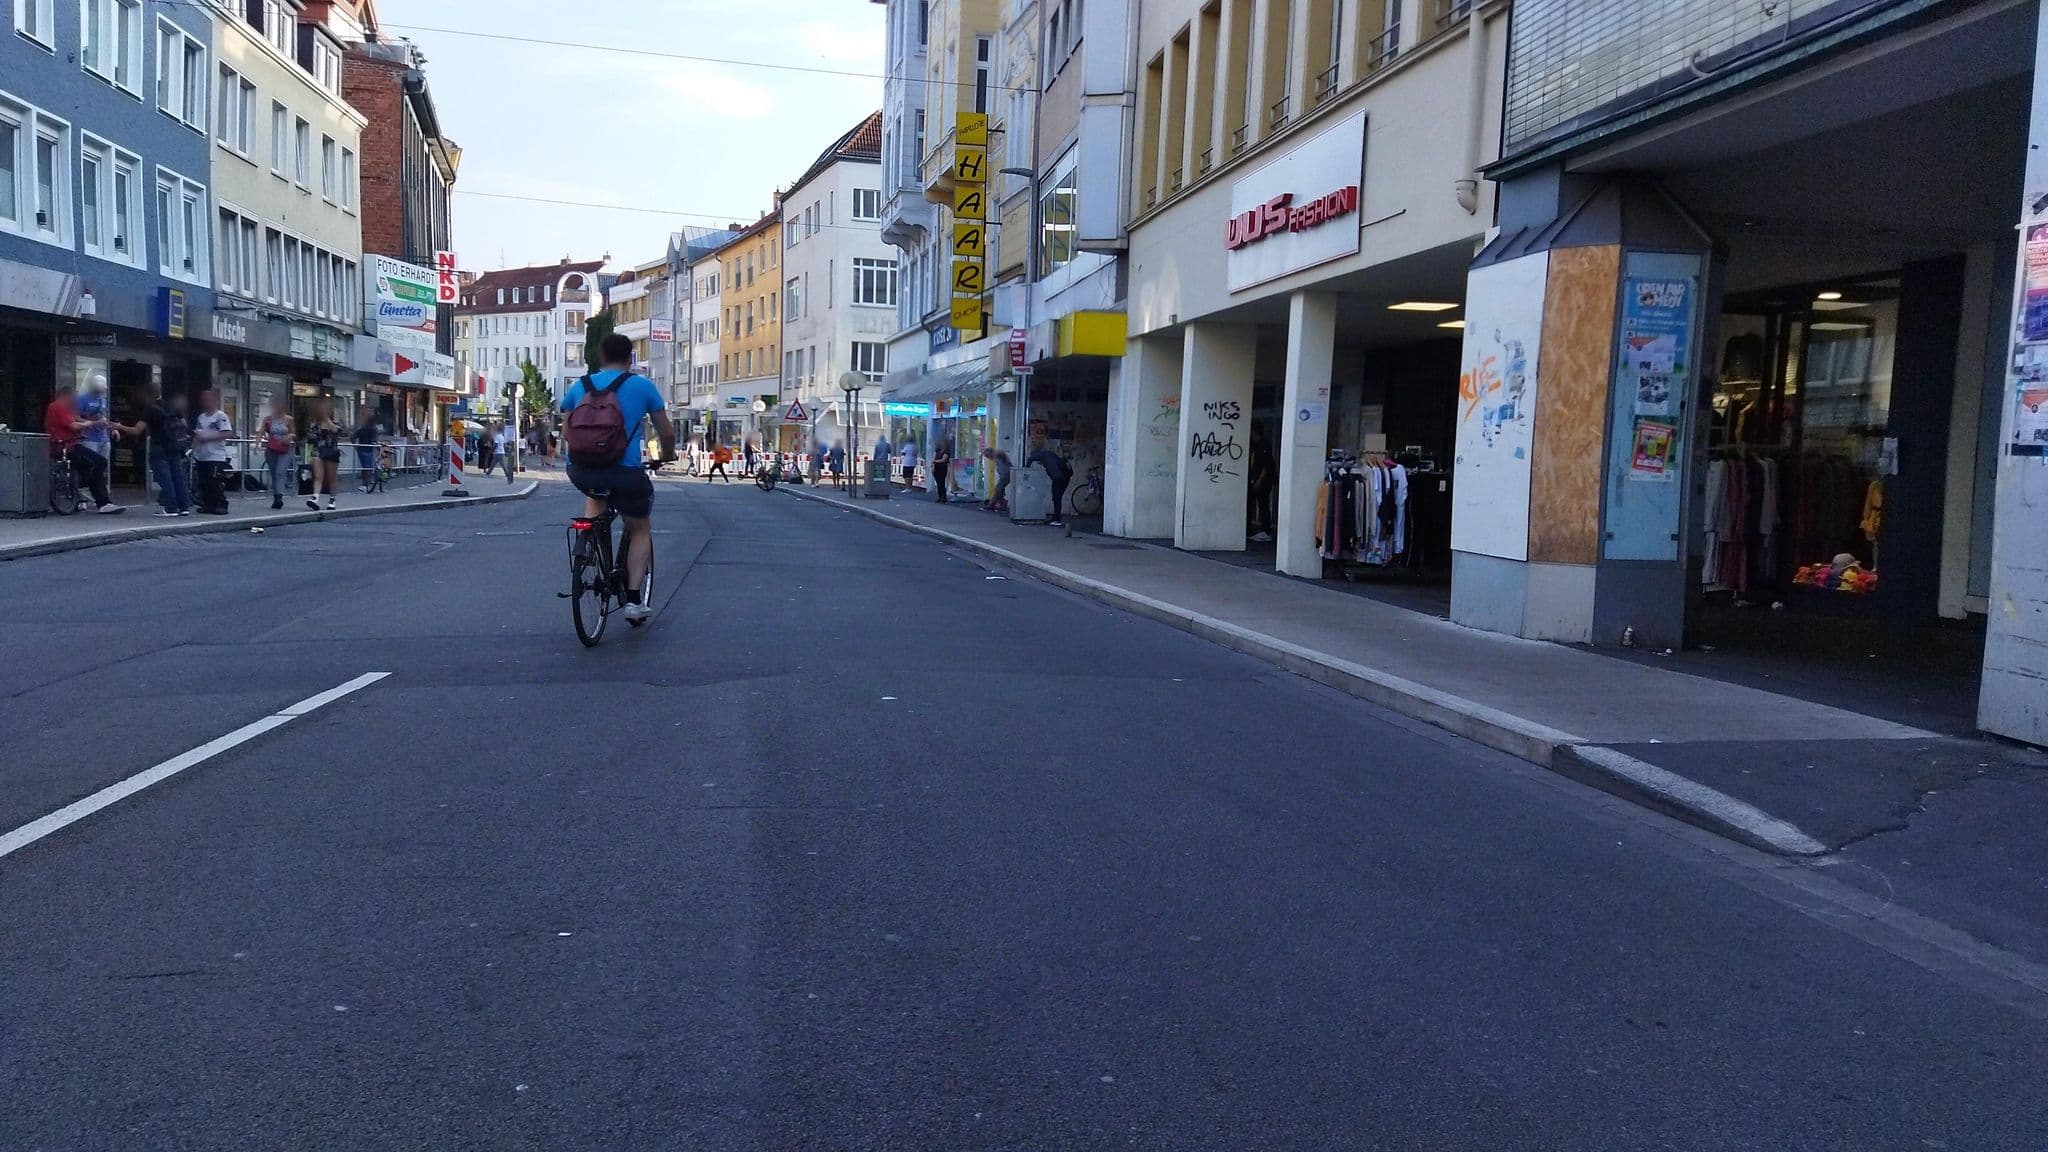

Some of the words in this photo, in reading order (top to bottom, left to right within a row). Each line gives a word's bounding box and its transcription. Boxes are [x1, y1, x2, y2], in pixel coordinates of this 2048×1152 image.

[956, 153, 983, 290] HAAR
[1289, 185, 1357, 233] FASHION
[377, 258, 399, 276] FOTO
[400, 265, 435, 285] ERHARDT
[438, 253, 456, 301] NKD
[1636, 282, 1665, 296] OPEN
[1664, 282, 1686, 296] AIR
[211, 314, 247, 343] Kutsche
[1203, 400, 1241, 412] NIKS
